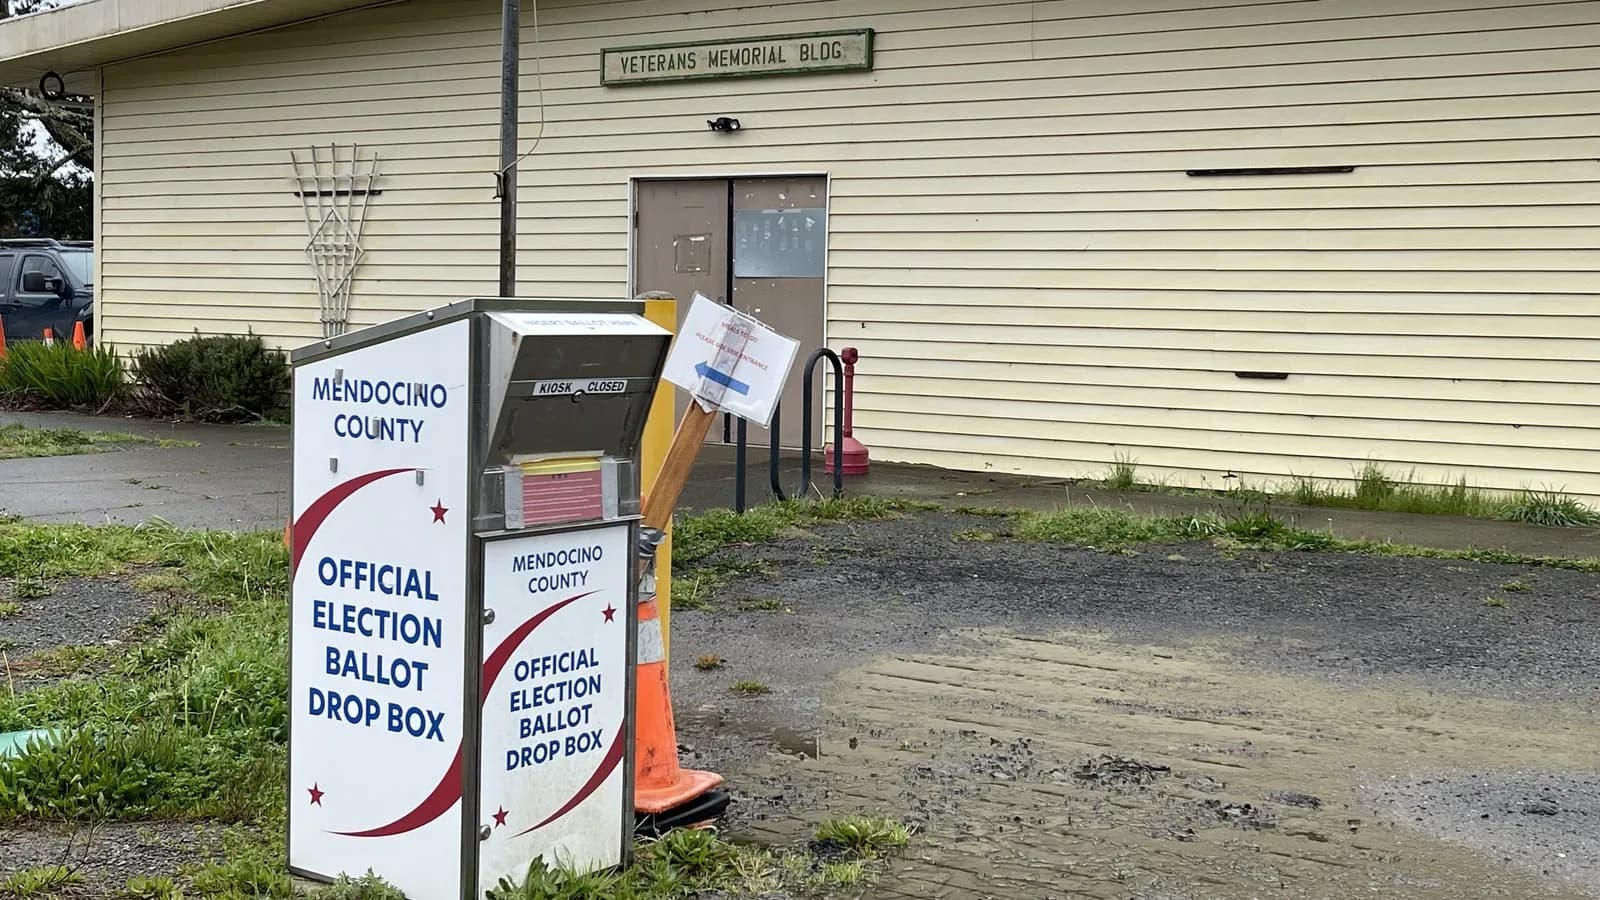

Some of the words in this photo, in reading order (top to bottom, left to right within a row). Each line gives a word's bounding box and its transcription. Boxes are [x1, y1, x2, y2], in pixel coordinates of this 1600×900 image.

[620, 51, 697, 75] VETERANS
[708, 45, 786, 69] MEMORIAL
[695, 332, 716, 347] PLEASE
[739, 352, 769, 372] ENTRANCE
[312, 377, 448, 409] MENDOCINO
[539, 382, 574, 394] KIOSK
[587, 381, 625, 392] CLOSED
[334, 413, 425, 443] COUNTY
[512, 545, 603, 573] MENDOCINO
[318, 556, 439, 602] OFFICIAL
[528, 570, 589, 594] COUNTY
[313, 599, 442, 649] ELECTION
[325, 645, 428, 690] BALLOT
[514, 647, 600, 682] OFFICIAL
[510, 674, 602, 713] ELECTION
[308, 687, 382, 728] DROP
[387, 703, 445, 742] BOX
[520, 703, 593, 739] BALLOT
[506, 740, 561, 771] DROP
[564, 728, 603, 757] BOX
